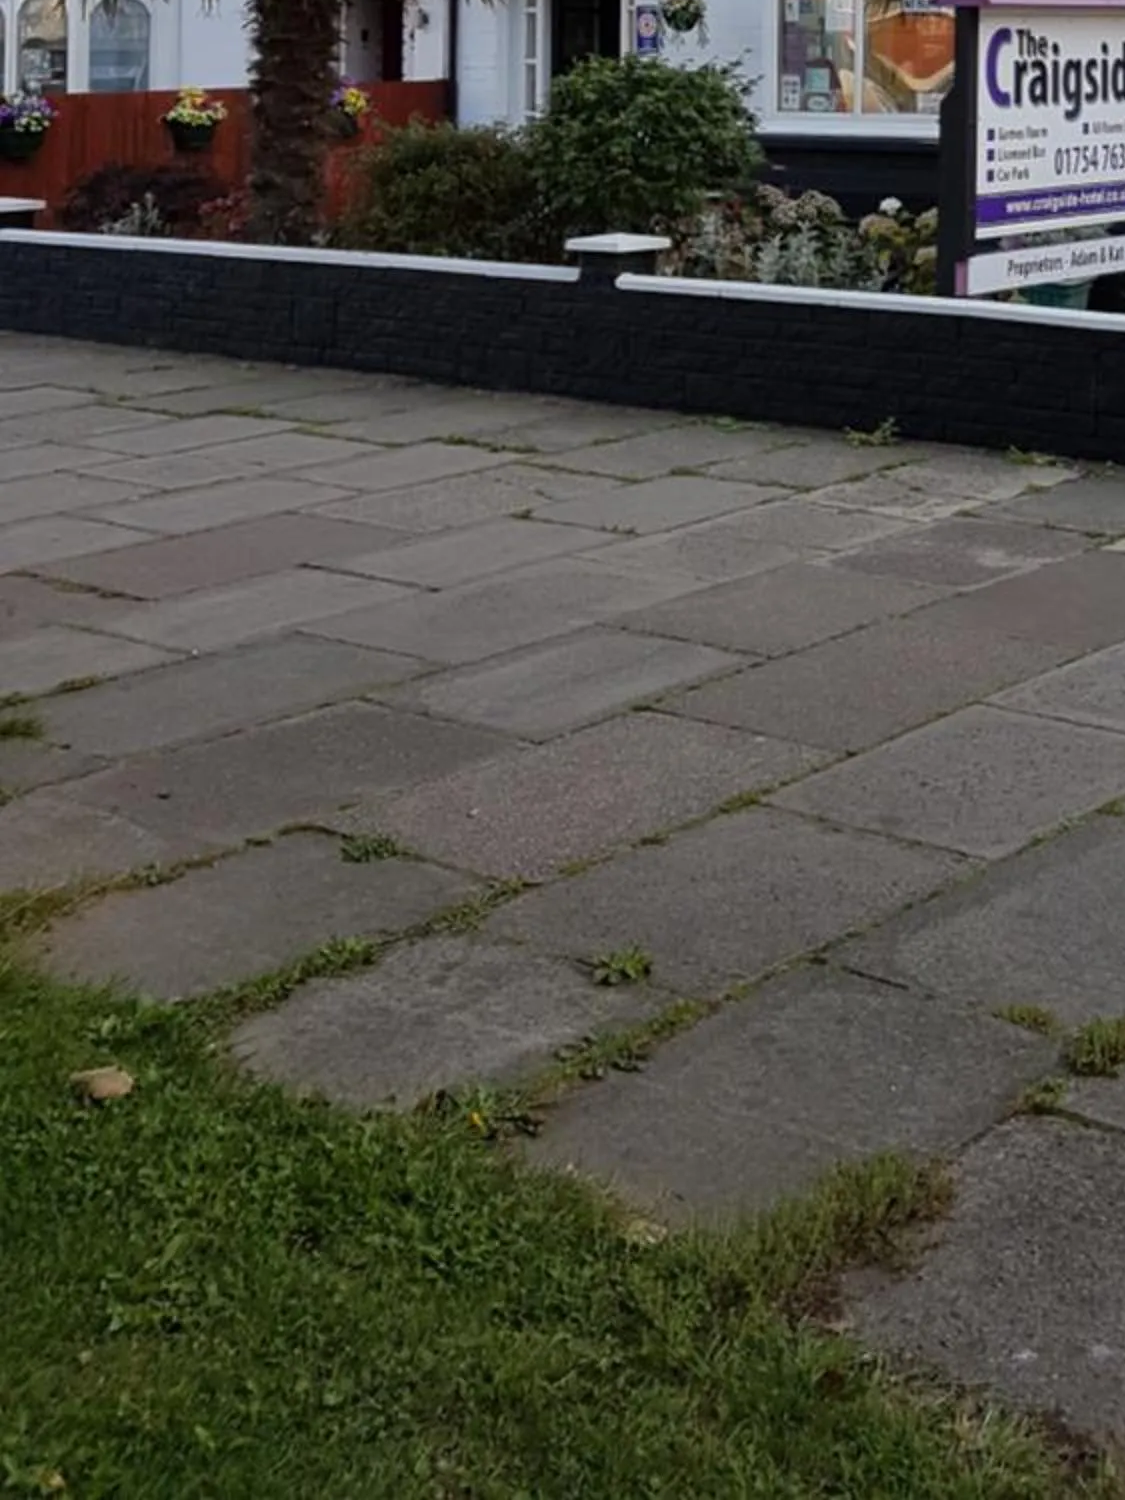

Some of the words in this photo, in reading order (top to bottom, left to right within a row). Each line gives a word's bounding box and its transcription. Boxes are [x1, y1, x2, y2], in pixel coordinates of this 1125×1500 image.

[1016, 28, 1048, 57] The
[1054, 146, 1099, 175] 01754
[1071, 249, 1098, 267] Adam
